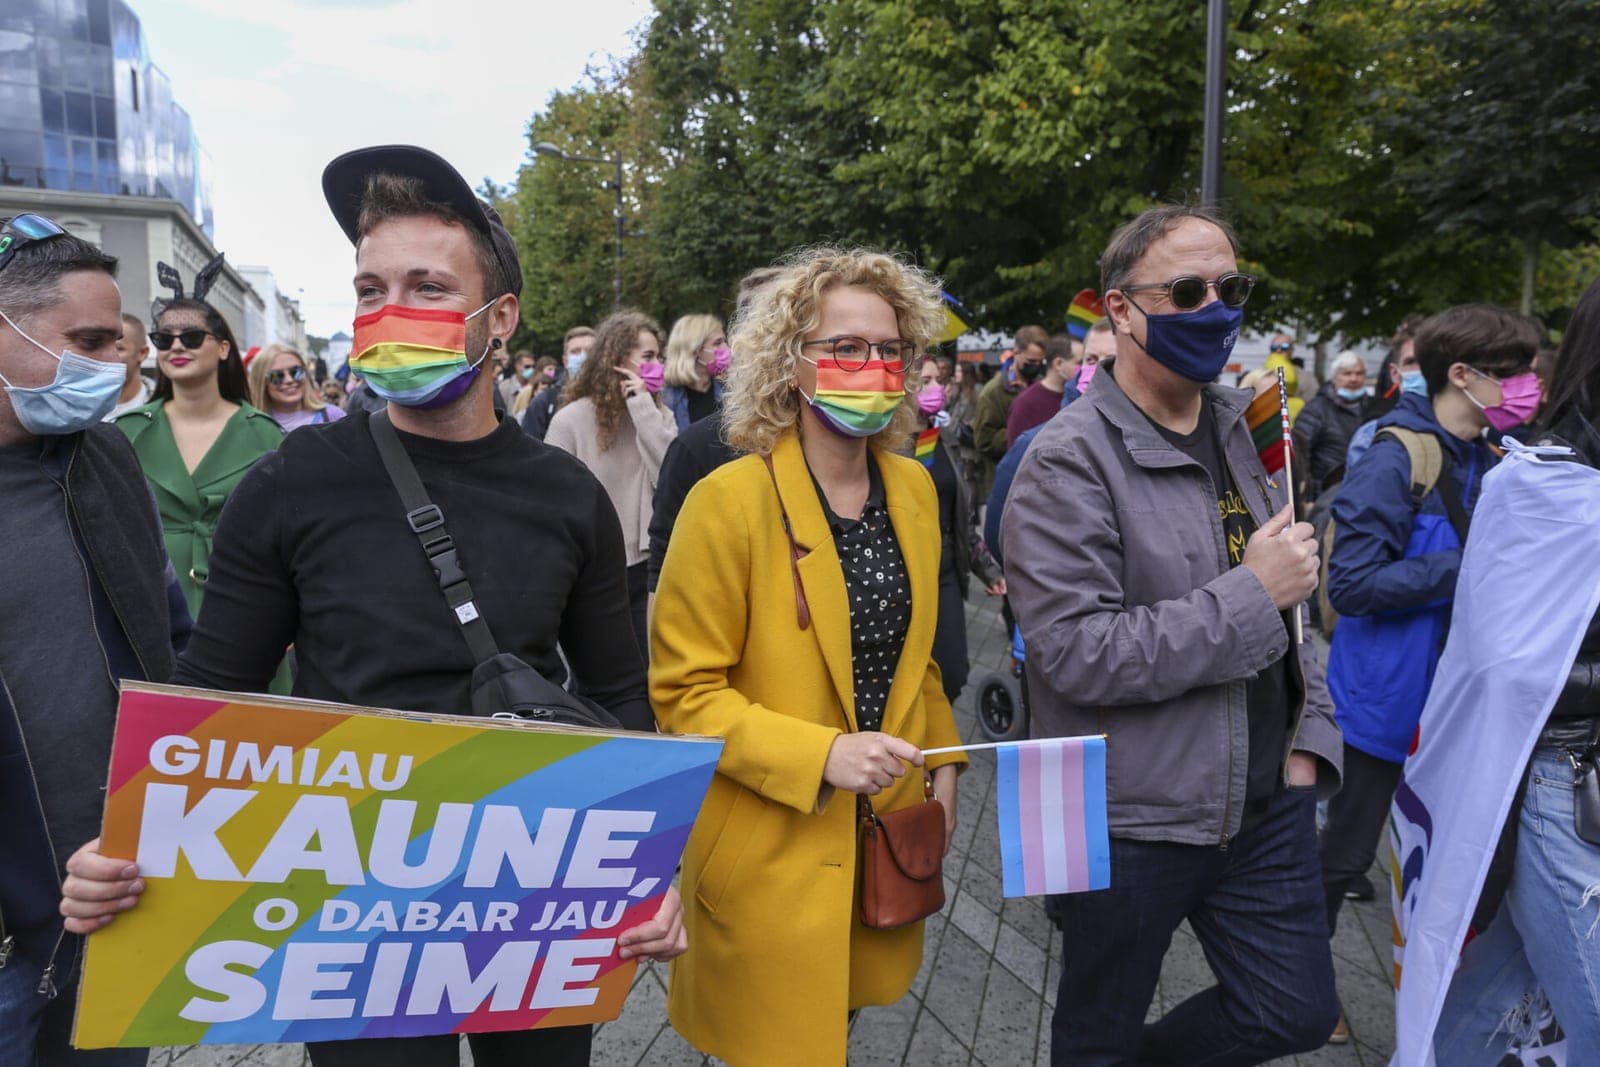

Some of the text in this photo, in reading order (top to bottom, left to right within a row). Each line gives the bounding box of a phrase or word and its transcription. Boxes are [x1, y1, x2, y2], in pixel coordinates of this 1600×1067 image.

[149, 735, 413, 791] GIMIAU
[136, 783, 661, 898] KAUNE,
[253, 898, 628, 932] O DABAR JAU
[179, 940, 617, 1023] SEIME
